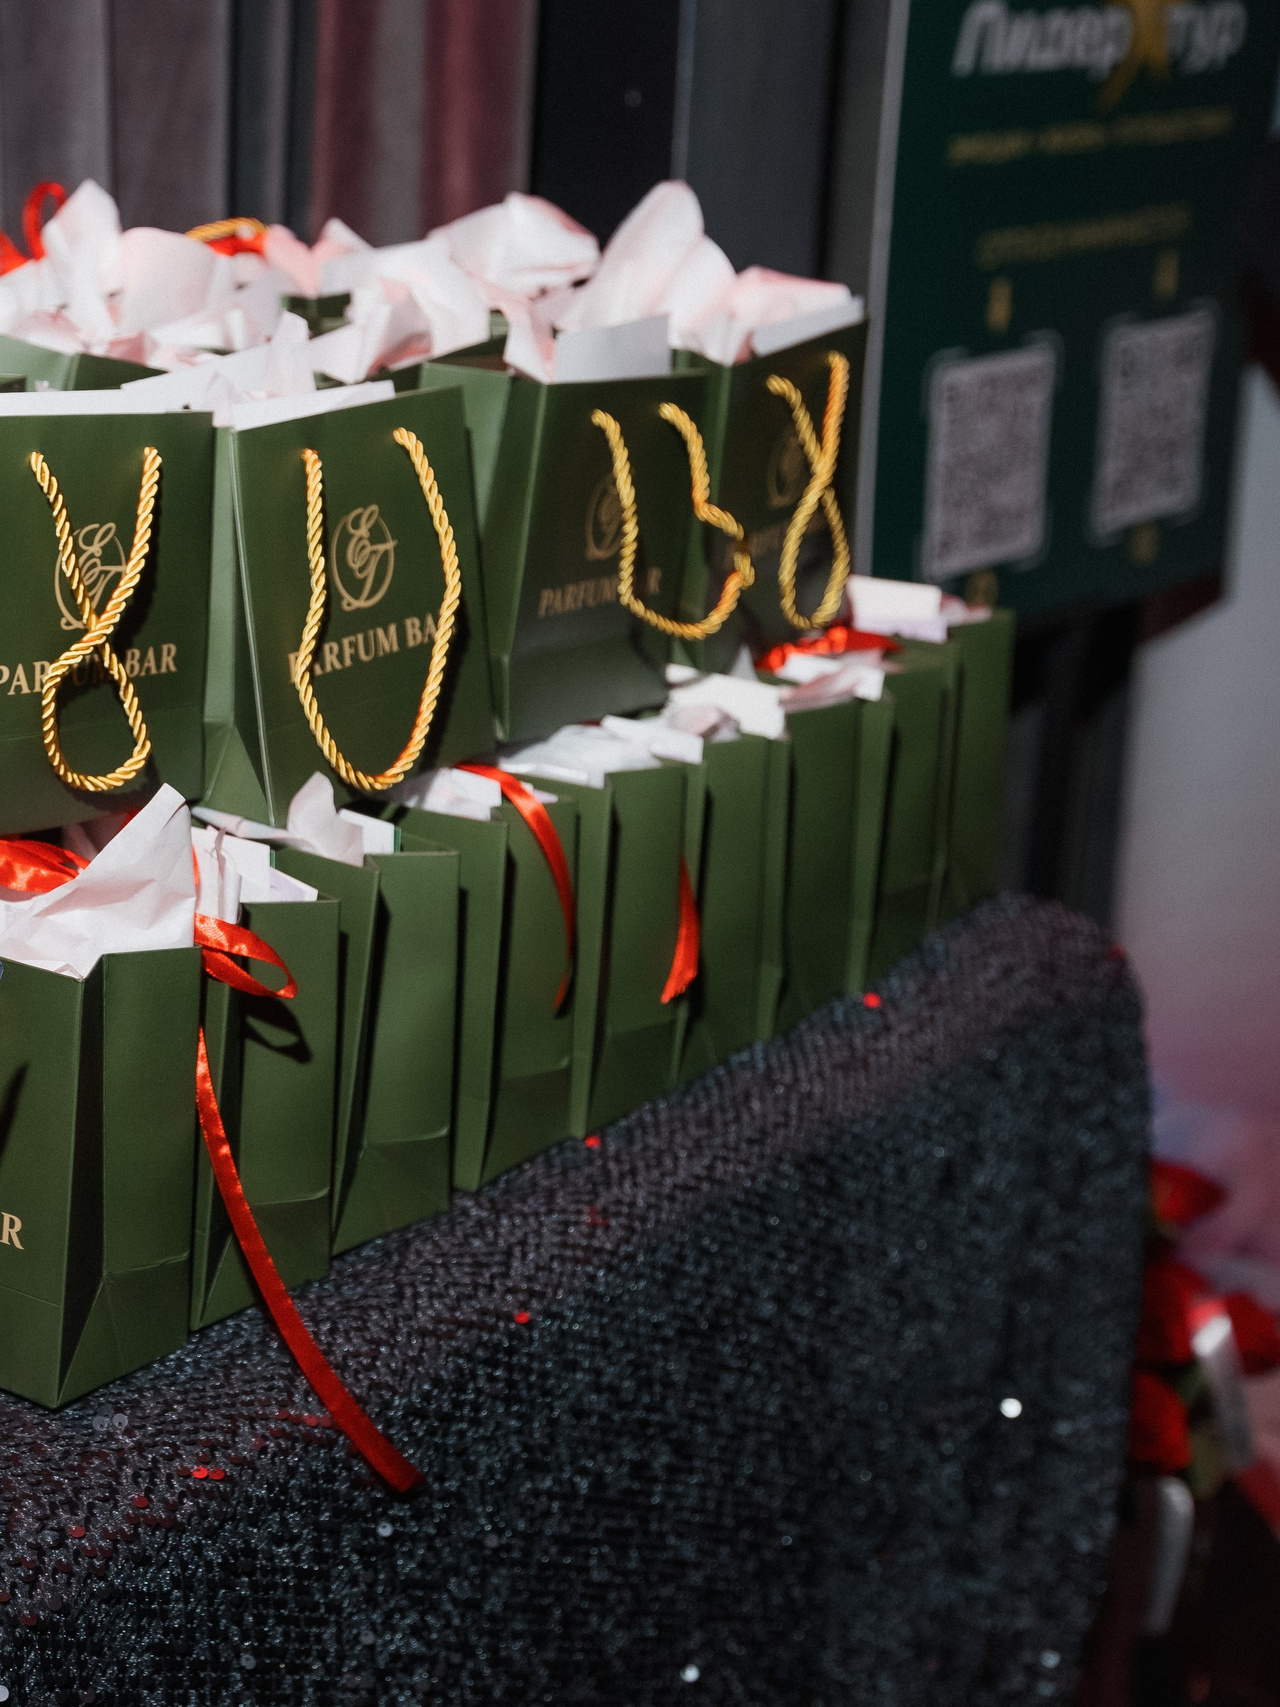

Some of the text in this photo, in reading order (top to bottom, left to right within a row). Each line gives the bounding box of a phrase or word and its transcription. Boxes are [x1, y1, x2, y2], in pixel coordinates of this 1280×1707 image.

[125, 643, 178, 678] BAR
[288, 612, 458, 684] PRFUM BA
